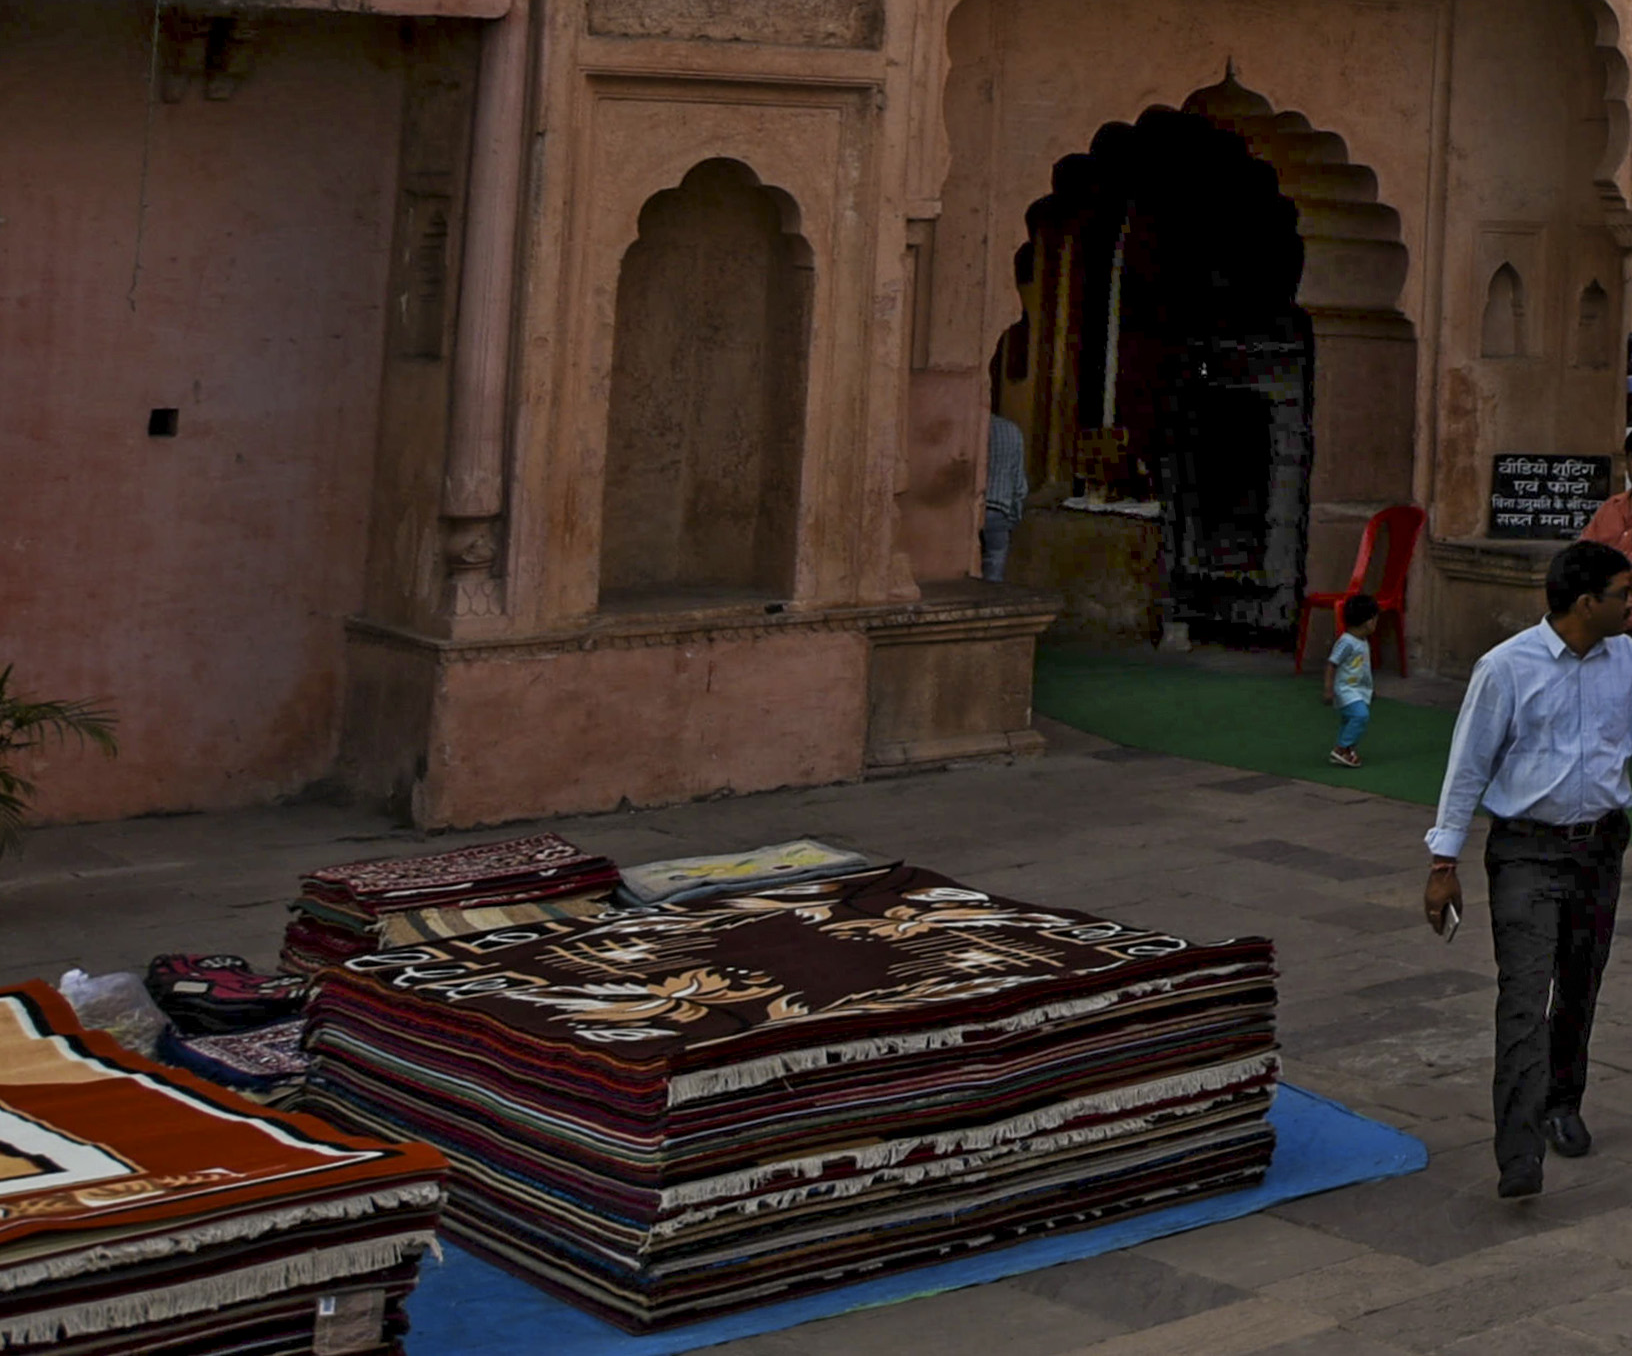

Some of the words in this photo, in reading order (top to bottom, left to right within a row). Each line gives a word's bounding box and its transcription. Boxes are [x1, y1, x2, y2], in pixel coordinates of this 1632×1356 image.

[1498, 457, 1548, 475] वीडियो
[1552, 459, 1596, 478] शूटिंग
[1514, 477, 1540, 495] एवं
[1547, 476, 1591, 494] फोटो
[1553, 495, 1565, 509] के
[1496, 514, 1533, 526] सख्त
[1539, 514, 1571, 527] मना
[1573, 511, 1587, 527] है
